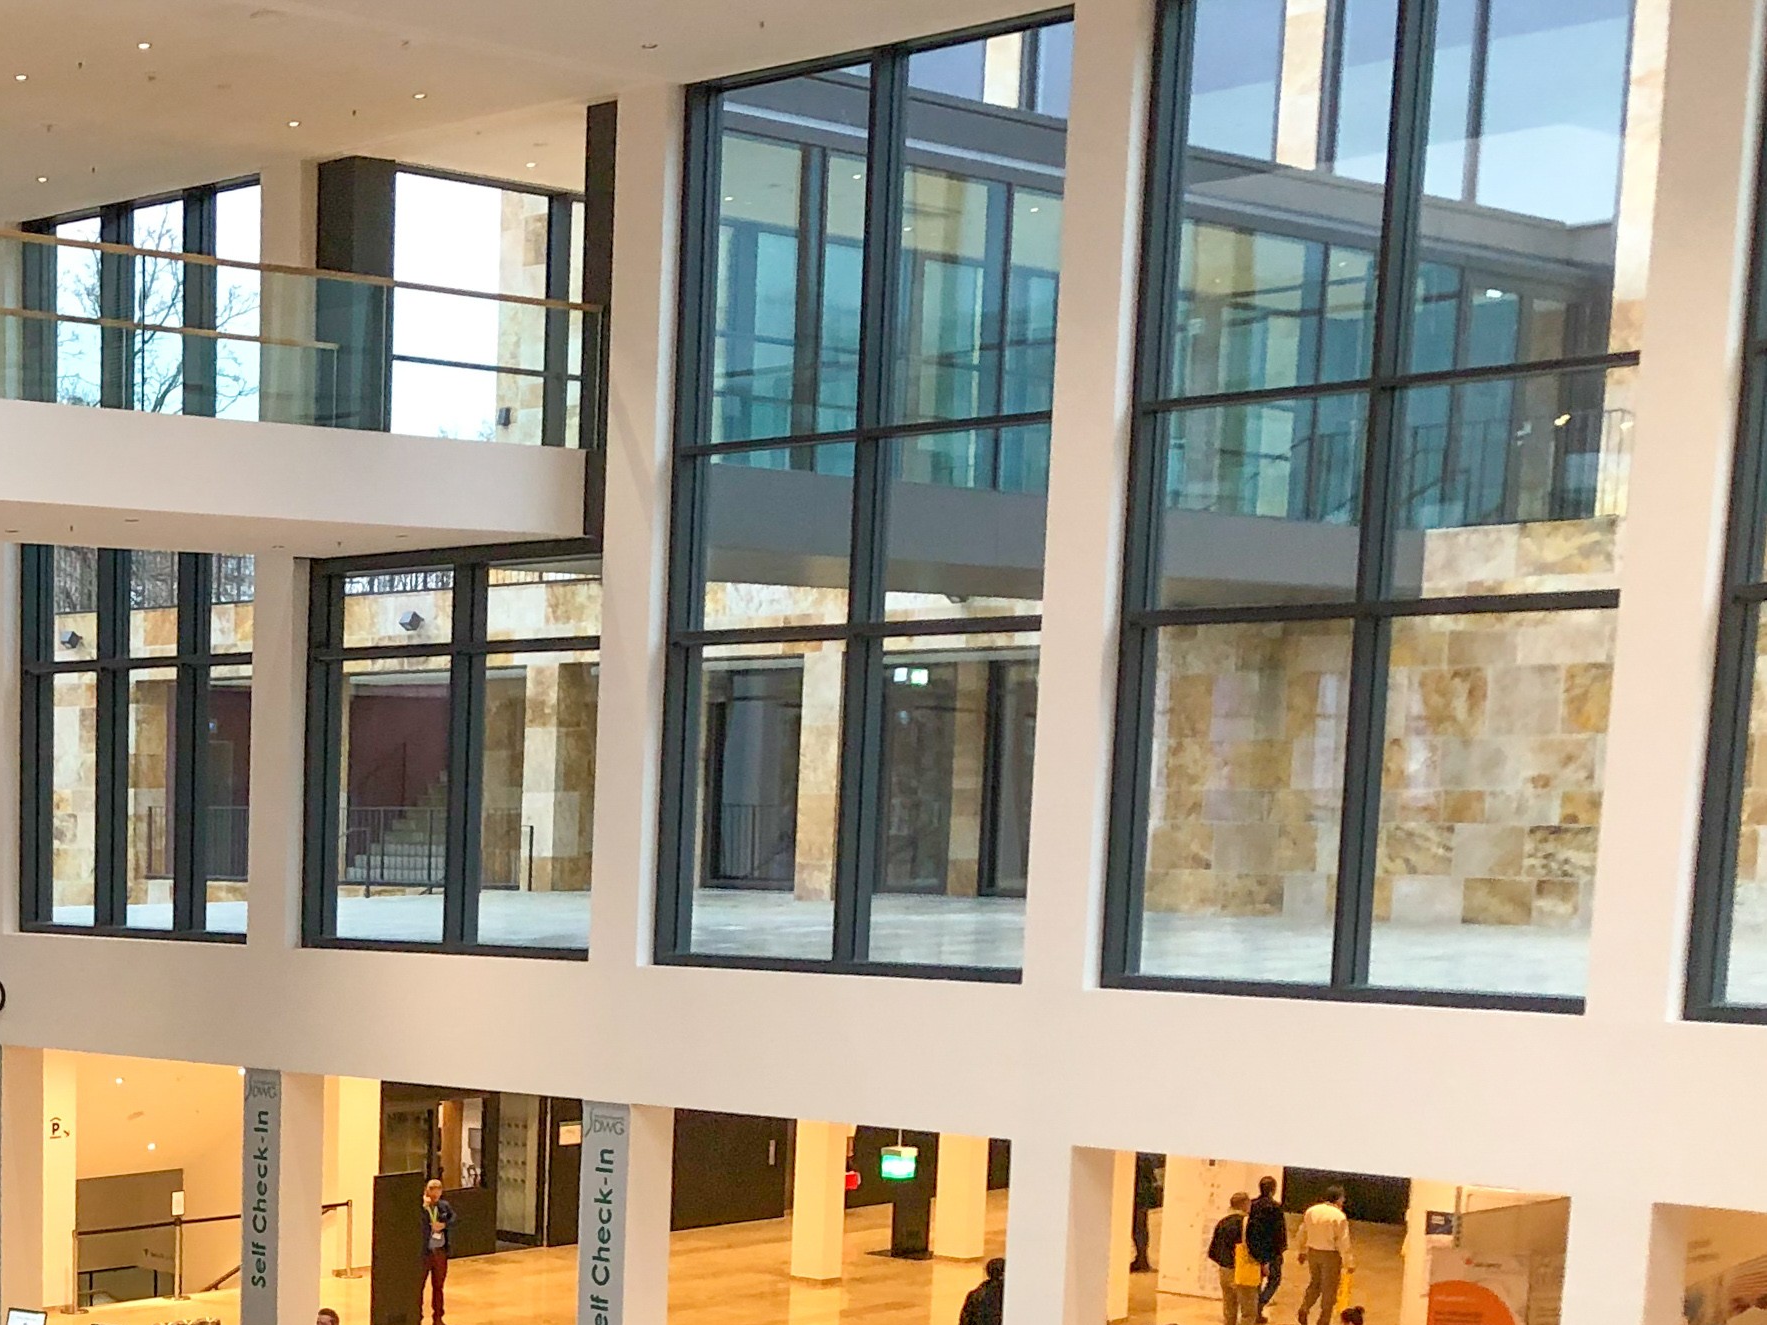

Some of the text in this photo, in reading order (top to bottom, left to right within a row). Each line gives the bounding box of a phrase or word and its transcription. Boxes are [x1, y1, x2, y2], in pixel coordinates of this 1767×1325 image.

[51, 1122, 60, 1136] P
[251, 1110, 269, 1289] Self Check-In
[591, 1148, 615, 1287] Check-In
